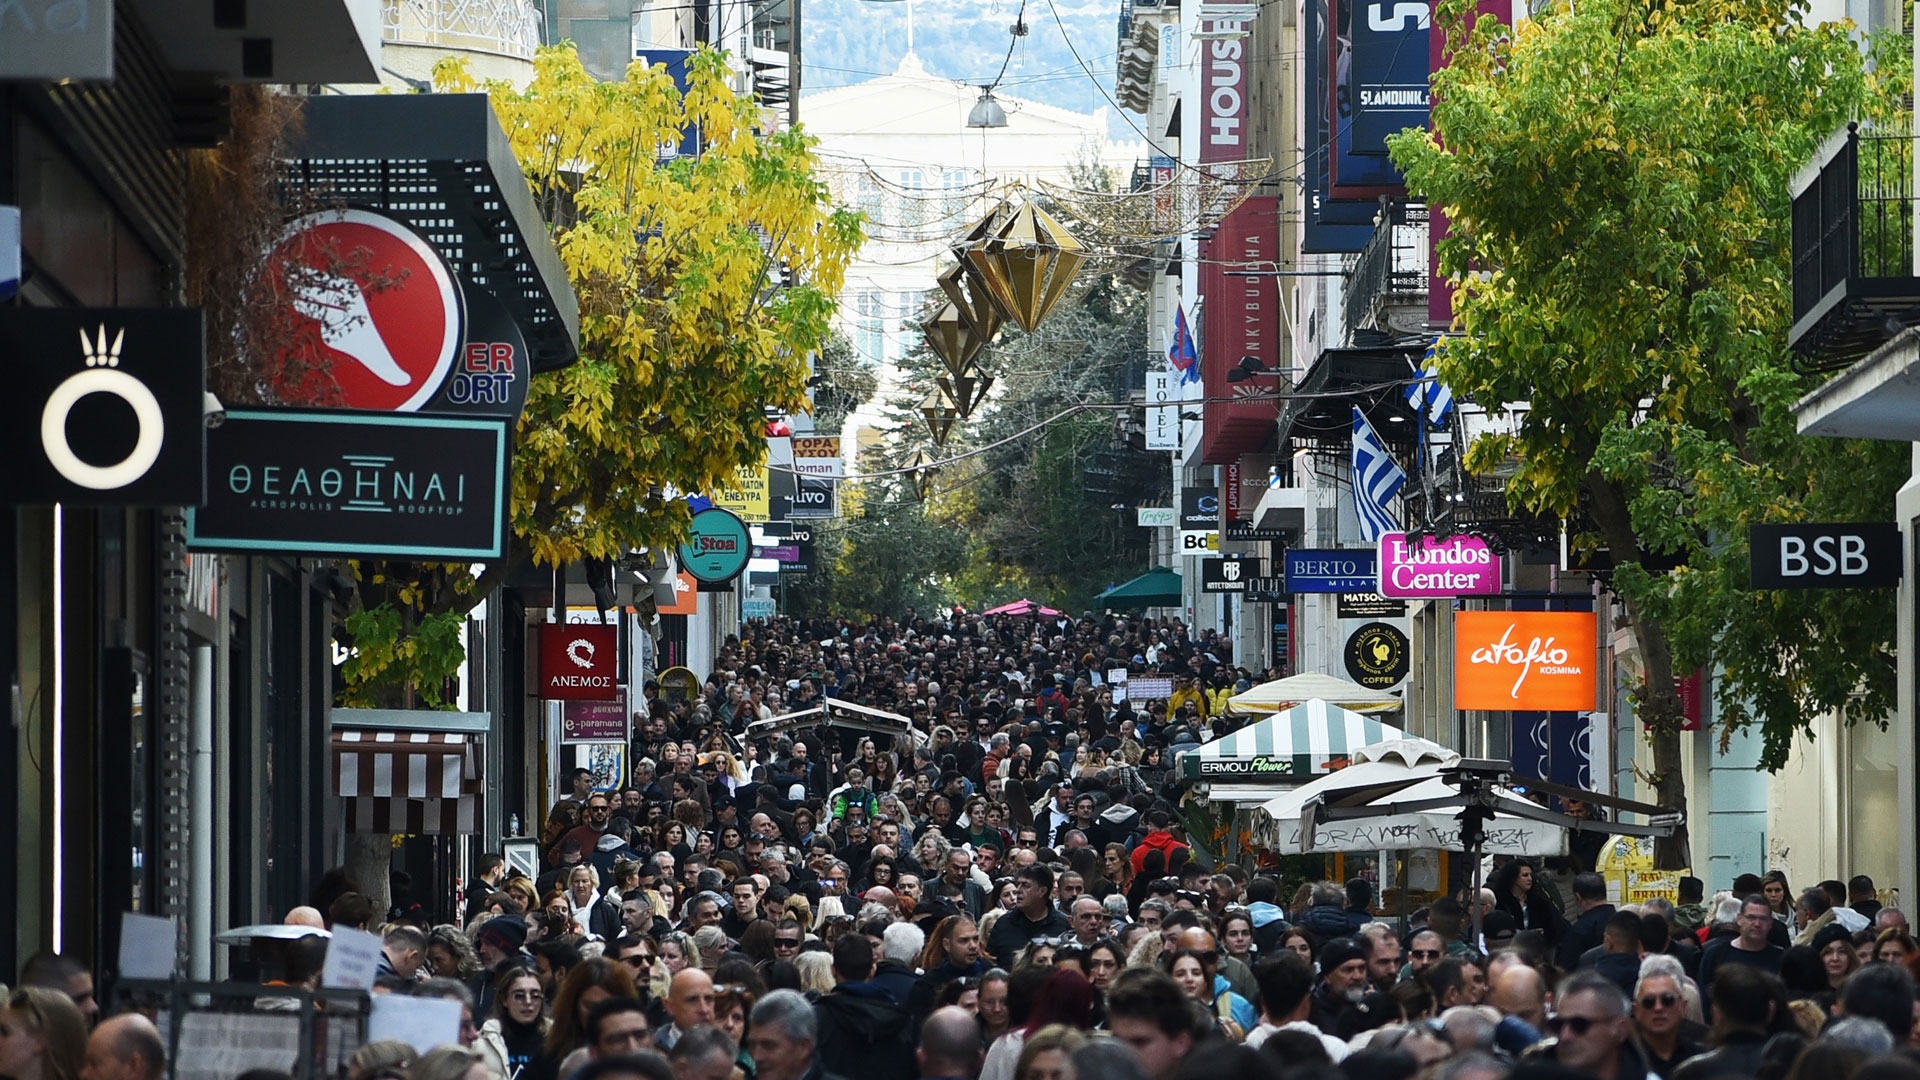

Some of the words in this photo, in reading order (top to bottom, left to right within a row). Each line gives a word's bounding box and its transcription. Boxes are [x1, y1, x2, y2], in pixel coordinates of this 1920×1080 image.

[1245, 235, 1261, 360] NKYBUDDHA
[465, 342, 515, 373] ER
[446, 372, 516, 404] ORT
[793, 439, 833, 449] ΓΟΡΑ
[794, 449, 839, 458] ΥΣΟΥ
[228, 463, 465, 504] ΘΕΑΘΗΝΑΙ
[1241, 478, 1269, 487] ecco
[251, 499, 332, 511] ACROPOLIS
[398, 504, 464, 516] ROOFTOP
[1391, 540, 1490, 565] Hondos
[1780, 535, 1869, 577] BSB
[1294, 560, 1357, 576] BERTO
[1391, 564, 1481, 590] Center
[1539, 666, 1582, 675] KOSMIMA
[550, 675, 611, 688] ΑΝΕΜΟΣ
[1362, 676, 1395, 684] COFFEE
[1201, 762, 1249, 773] ERMOU
[1250, 756, 1292, 773] Flower
